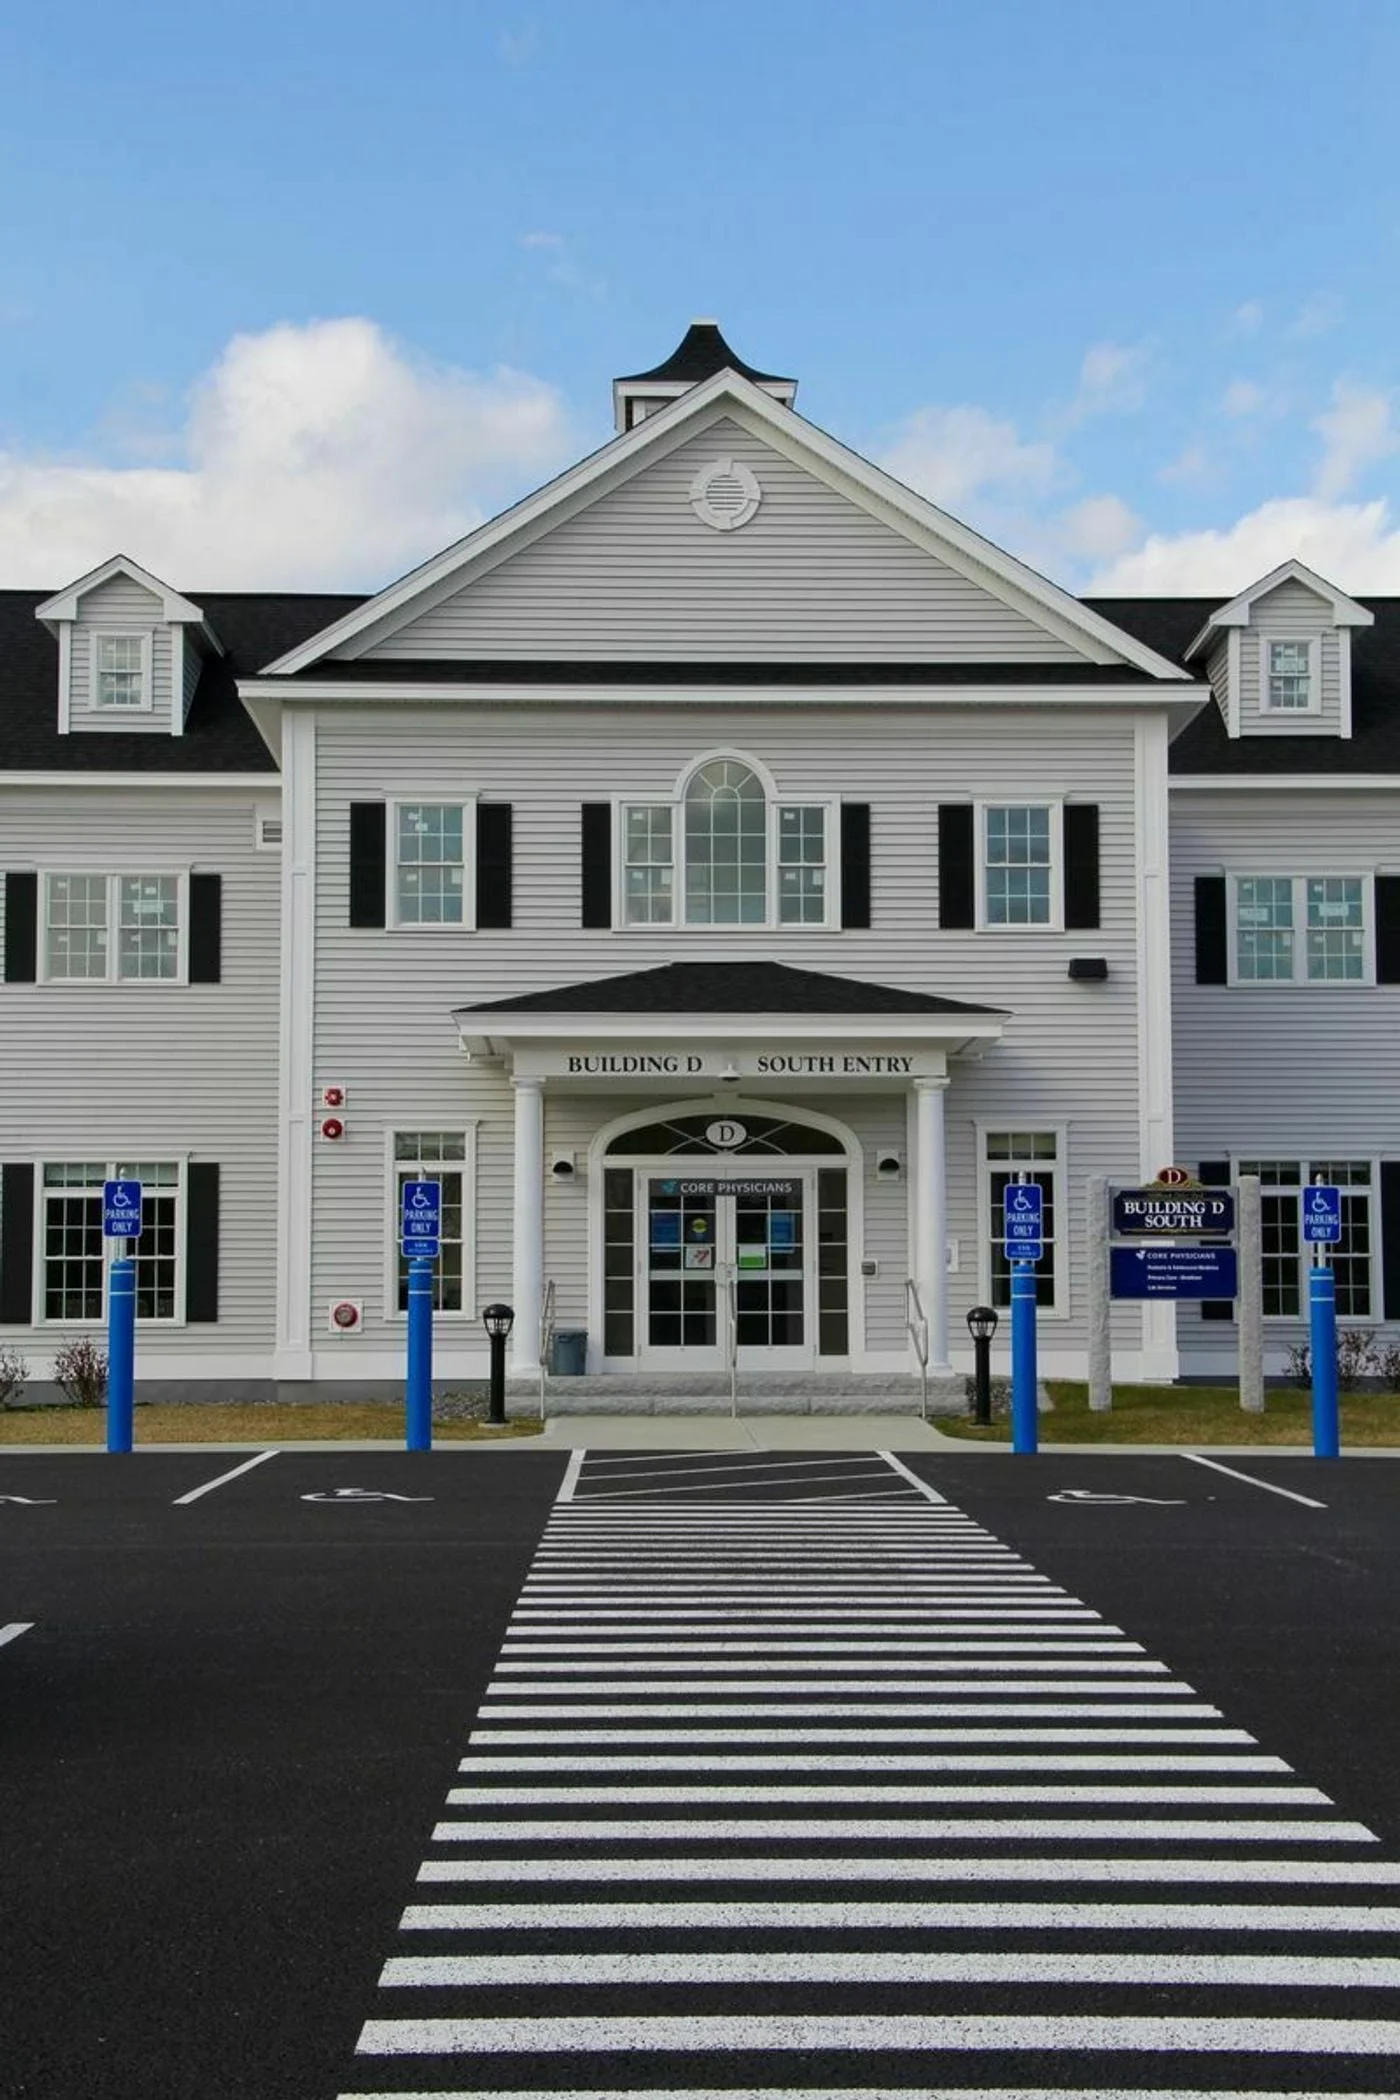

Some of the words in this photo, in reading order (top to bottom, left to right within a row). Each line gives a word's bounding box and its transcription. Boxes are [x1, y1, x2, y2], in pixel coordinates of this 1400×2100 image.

[568, 1056, 678, 1072] BUILDING
[687, 1056, 702, 1072] D
[757, 1056, 834, 1072] SOUTH
[843, 1056, 913, 1072] ENTRY
[719, 1125, 735, 1141] D
[1167, 1170, 1181, 1184] D
[680, 1182, 714, 1193] CORE
[718, 1182, 793, 1193] PHYSICIANS
[1124, 1201, 1205, 1214] BUILDING
[1212, 1201, 1225, 1214] D
[105, 1208, 139, 1220] PARKING
[405, 1209, 438, 1221] PARKING
[1007, 1213, 1040, 1223] PARKING
[1305, 1214, 1338, 1225] PARKING
[112, 1221, 132, 1233] ONLY
[1144, 1215, 1202, 1228] SOUTH
[411, 1222, 431, 1234] ONLY
[1013, 1225, 1034, 1237] ONLY
[1311, 1227, 1332, 1238] ONLY
[1147, 1252, 1168, 1260] CORE
[1170, 1252, 1216, 1260] PHYSICIANS
